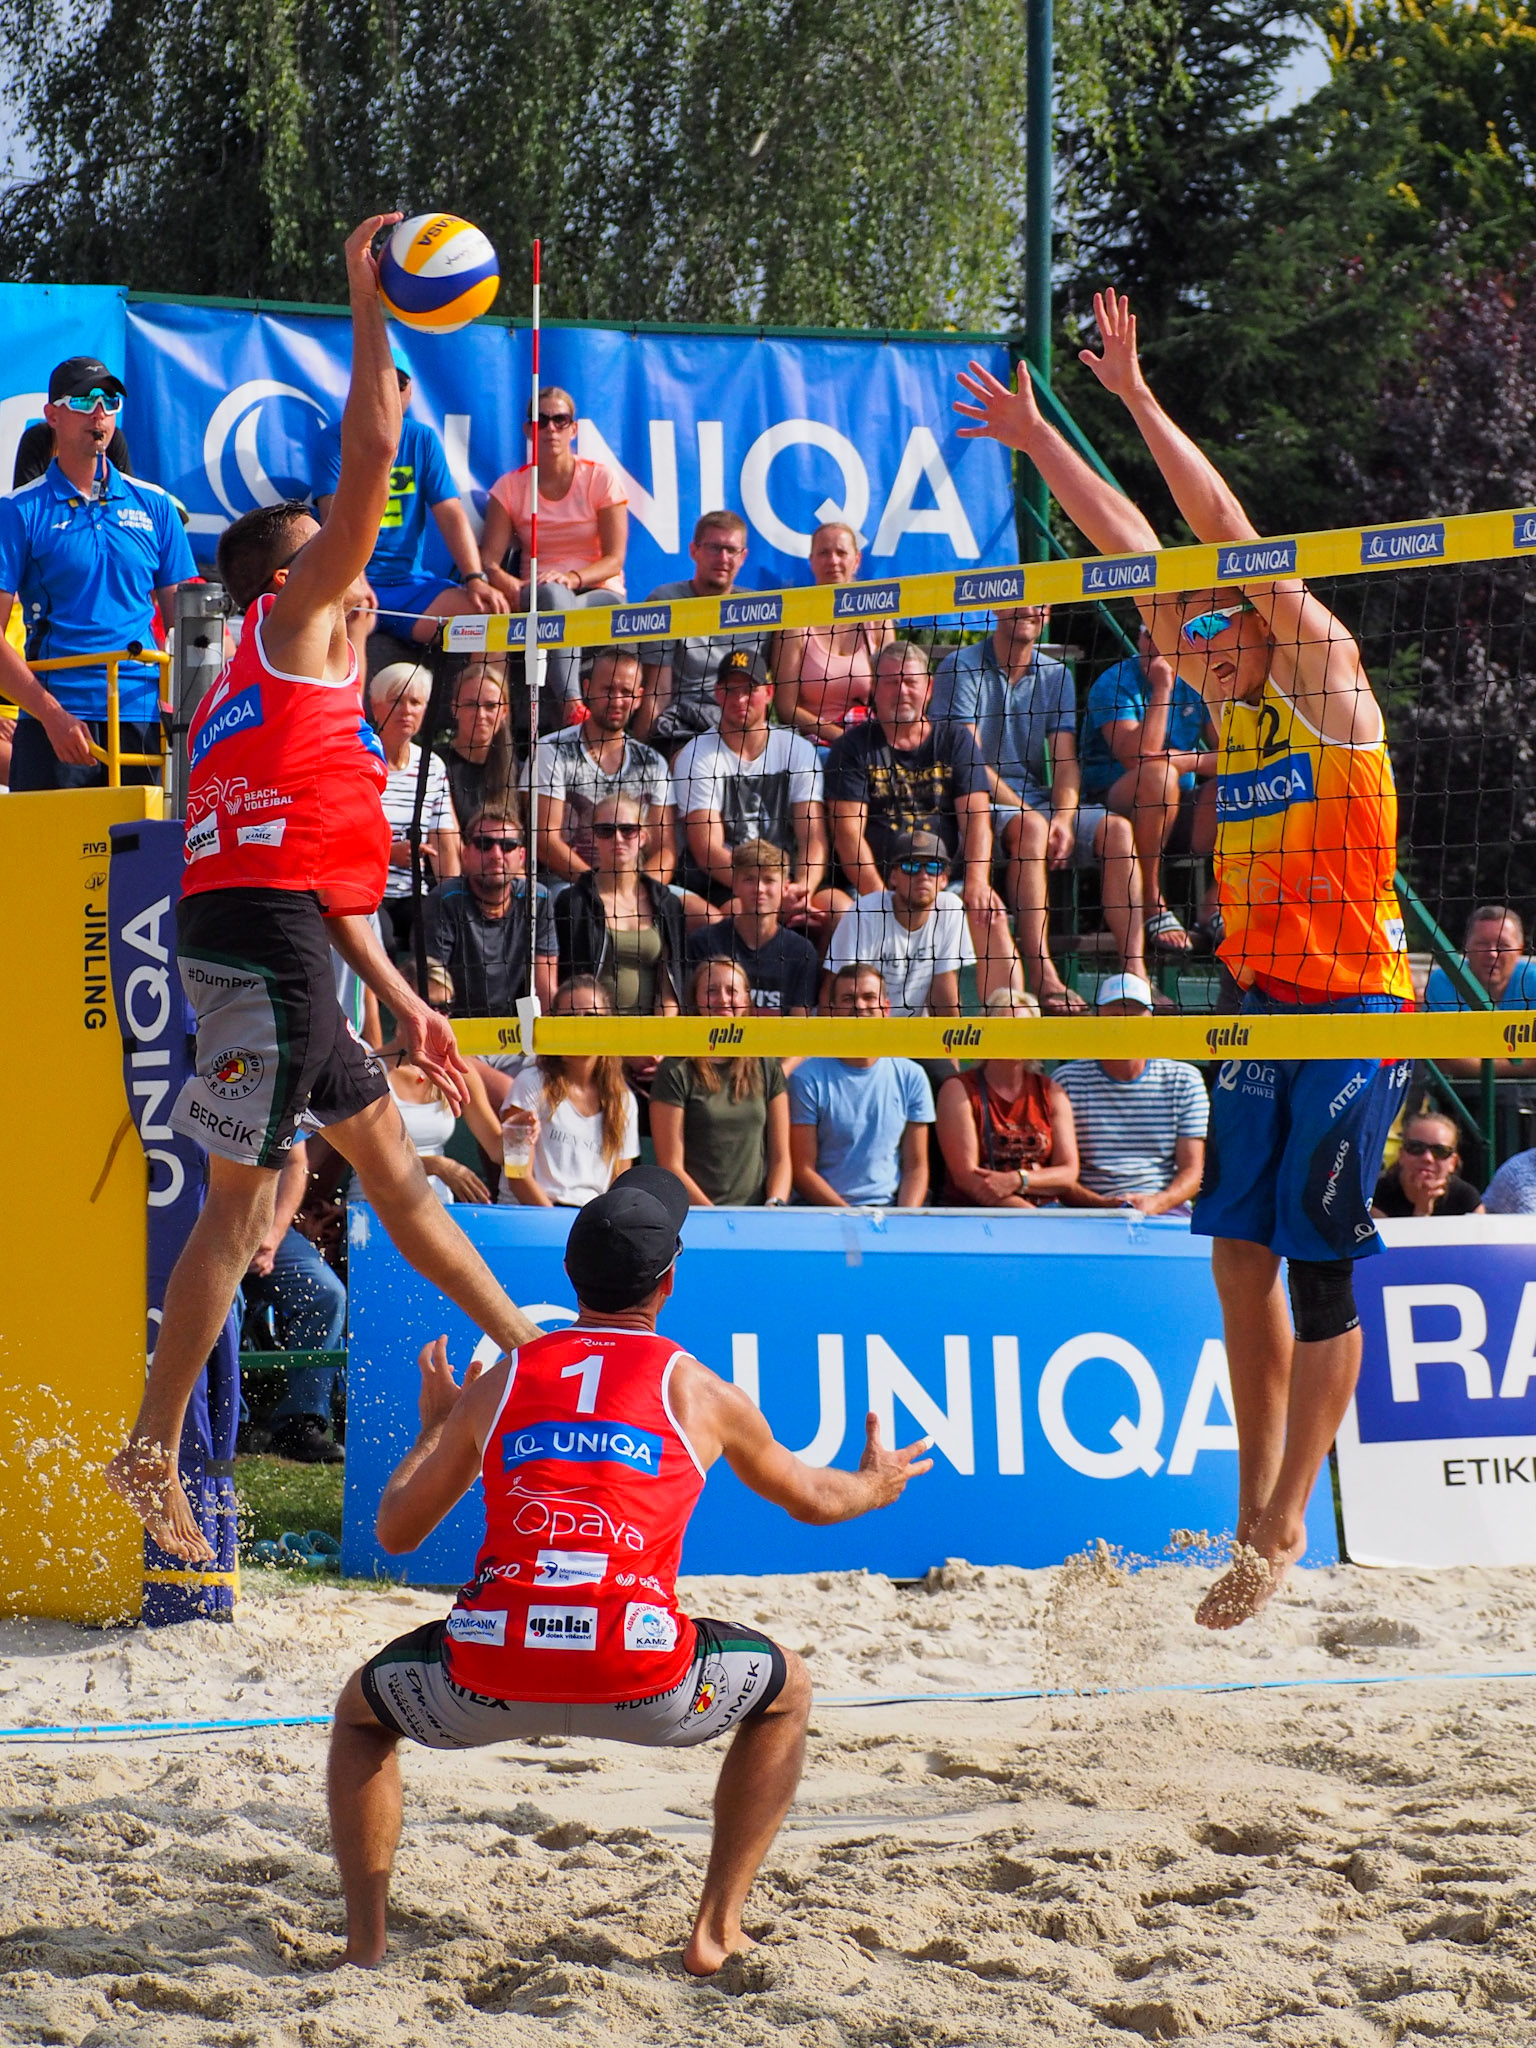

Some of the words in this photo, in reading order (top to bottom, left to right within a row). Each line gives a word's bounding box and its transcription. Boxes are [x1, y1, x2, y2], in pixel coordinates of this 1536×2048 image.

[1390, 533, 1438, 557] UNIQA
[1244, 549, 1290, 573] UNIQA
[1108, 564, 1151, 586] UNIQA
[979, 578, 1019, 599] UNIQA
[742, 603, 777, 622] UNIQA
[856, 591, 895, 612] UNIQA
[536, 621, 560, 639] NIQA
[631, 613, 666, 632] UNIQA
[1257, 704, 1290, 758] 2
[244, 788, 278, 802] BEACH
[244, 795, 294, 811] VOLEJBAL
[84, 903, 106, 1029] JINLING
[498, 1023, 521, 1050] gal
[708, 1023, 744, 1051] gala
[942, 1023, 982, 1054] gala
[1206, 1022, 1250, 1055] gala
[1503, 1017, 1536, 1052] gal
[121, 895, 186, 1208] UNIQA
[1329, 1072, 1368, 1119] ATEX
[189, 1100, 257, 1147] BERČÍK
[560, 1354, 604, 1414] 1
[553, 1431, 652, 1466] UNIQA
[529, 1615, 590, 1638] gala
[636, 1637, 668, 1646] KAMIZ
